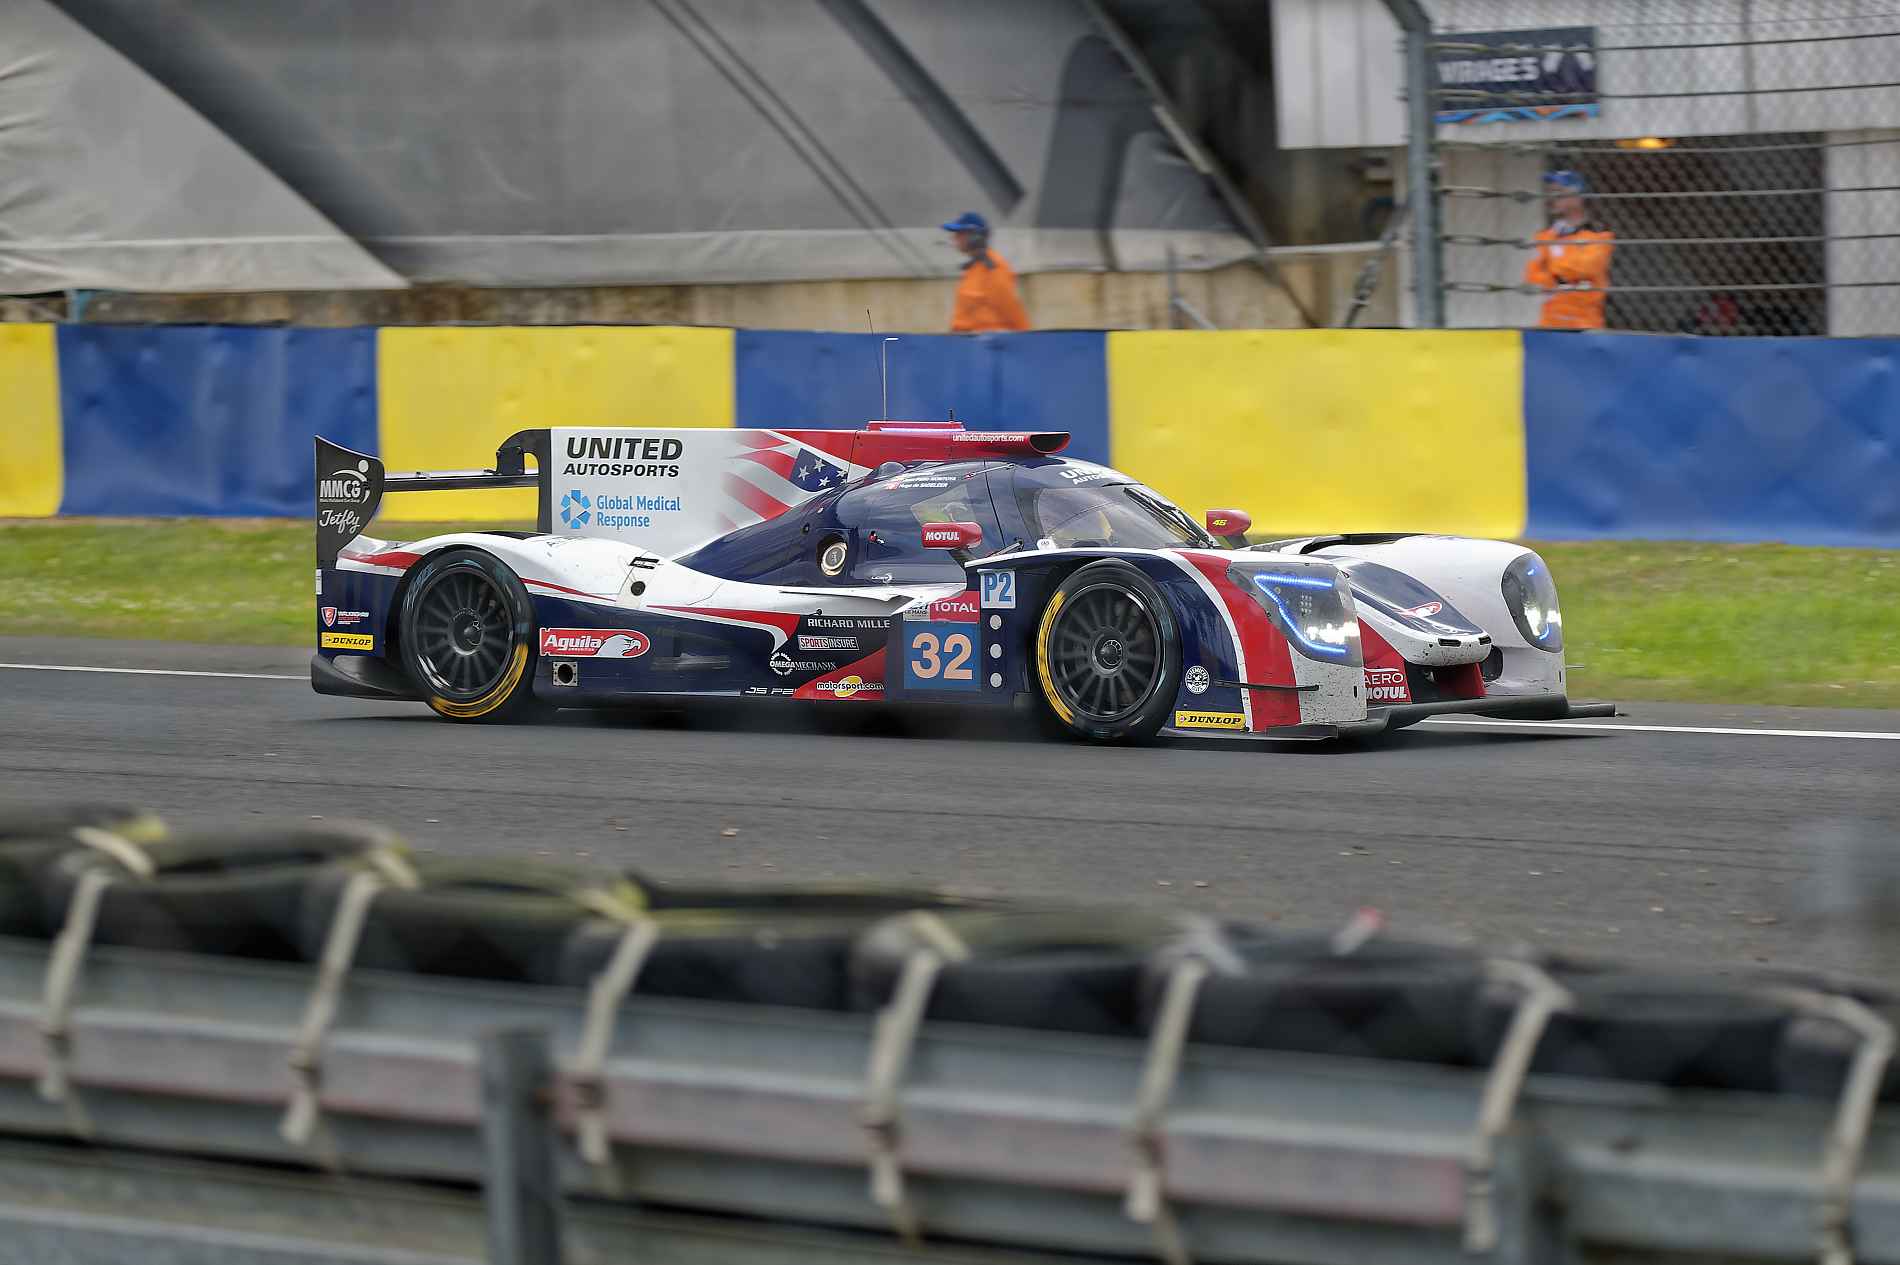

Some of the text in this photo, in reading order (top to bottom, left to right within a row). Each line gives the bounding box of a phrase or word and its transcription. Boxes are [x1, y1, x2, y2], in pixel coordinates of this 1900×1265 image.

[566, 436, 684, 461] UNITED
[562, 463, 681, 478] AUTOSPORTS
[319, 480, 361, 498] MMCG
[596, 495, 681, 511] Global Medical
[319, 509, 361, 534] Jetfly
[597, 512, 650, 531] Response
[925, 531, 960, 541] MOTUL
[984, 572, 1012, 602] P2
[935, 602, 979, 613] TOTAL
[807, 618, 891, 629] RICHARD MILLE
[331, 637, 372, 646] DUNLOP
[544, 633, 602, 651] Aguila
[911, 632, 973, 680] 32
[816, 680, 884, 692] motorsport.com
[1188, 715, 1241, 725] DUNLOP
